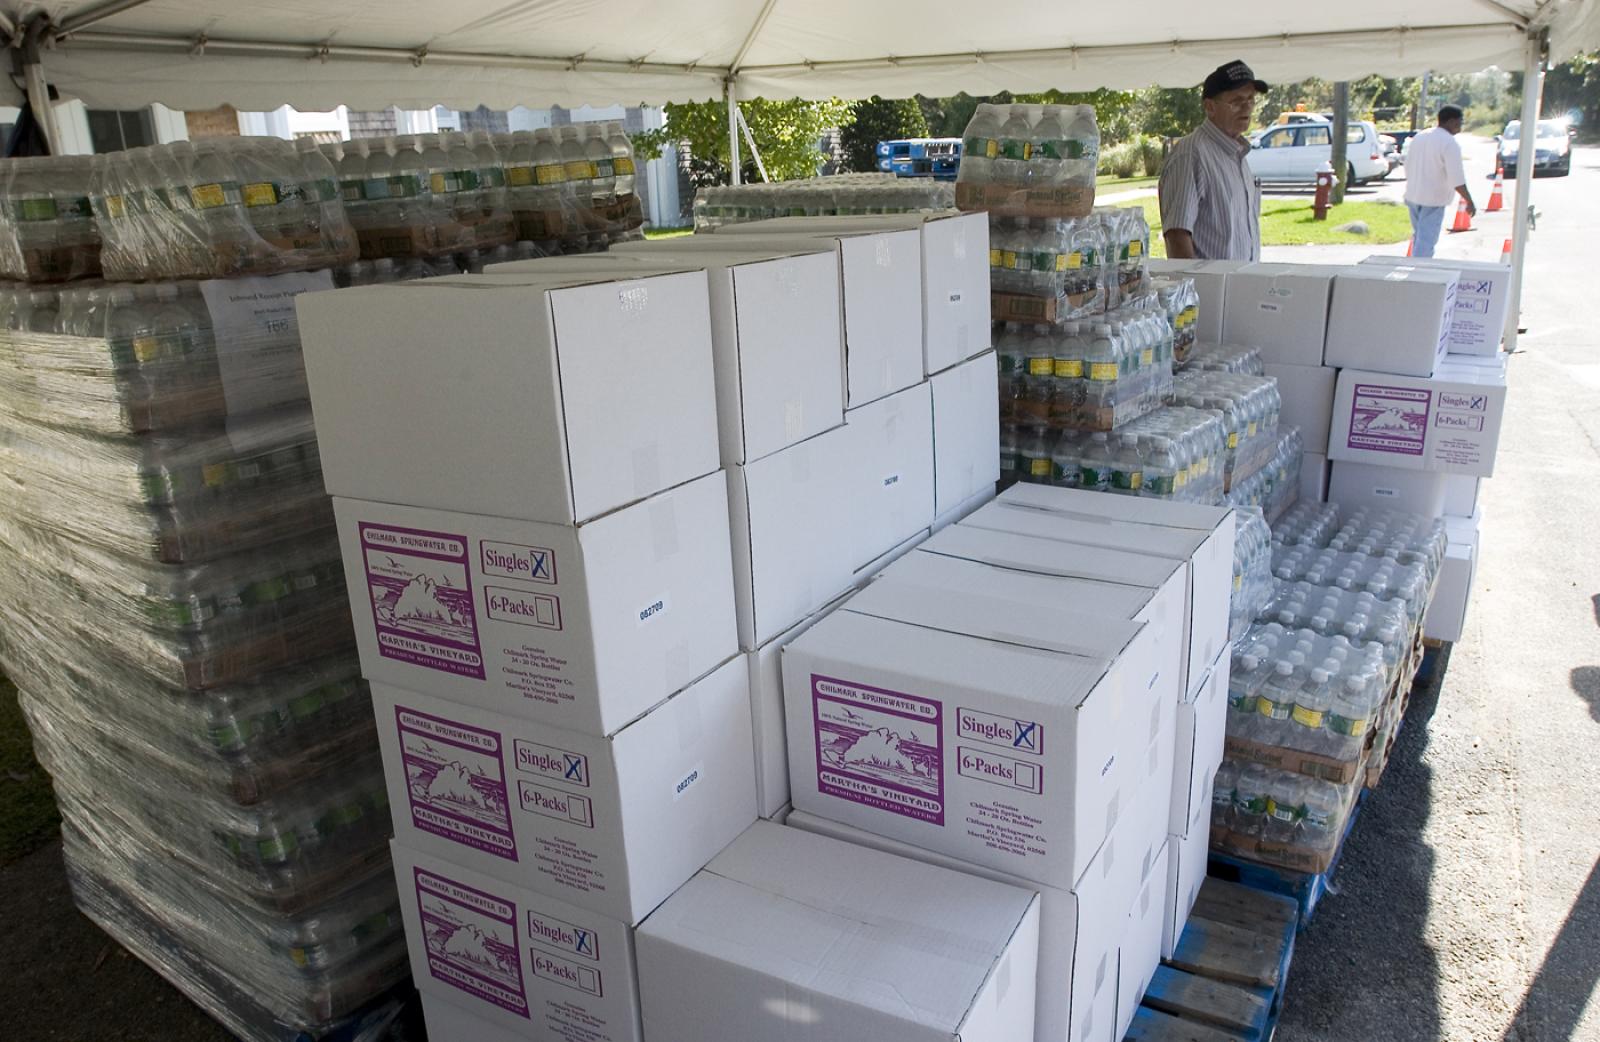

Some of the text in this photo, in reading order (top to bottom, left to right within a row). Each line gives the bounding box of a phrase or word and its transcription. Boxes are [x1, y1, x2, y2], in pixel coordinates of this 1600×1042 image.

[1442, 396, 1469, 407] Singles
[1439, 416, 1466, 425] 6-Packs
[400, 536, 446, 552] SPRINGWATER
[485, 549, 529, 573] Singles
[490, 595, 535, 617] 6-Packs
[380, 634, 479, 663] MARTHA'S VINEYARD
[820, 683, 858, 698] CHILMARK
[861, 692, 916, 711] SPRINGWATER
[962, 715, 1012, 740] Singles
[519, 747, 563, 772] Singles
[962, 755, 1013, 780] 6-Packs
[523, 788, 568, 813] 6-Packs
[822, 773, 939, 811] MARTHA'S VINEYARD
[970, 801, 1042, 824] Chilmark Spring Water
[993, 801, 1019, 812] Genuine
[415, 808, 513, 847] MARTHA'S VINEYARD
[966, 817, 995, 829] Chilmark
[996, 825, 1034, 839] Springwater
[1012, 818, 1034, 829] Bottles
[967, 830, 995, 842] Martha's
[532, 918, 574, 944] Singles
[535, 957, 577, 982] 6-Packs
